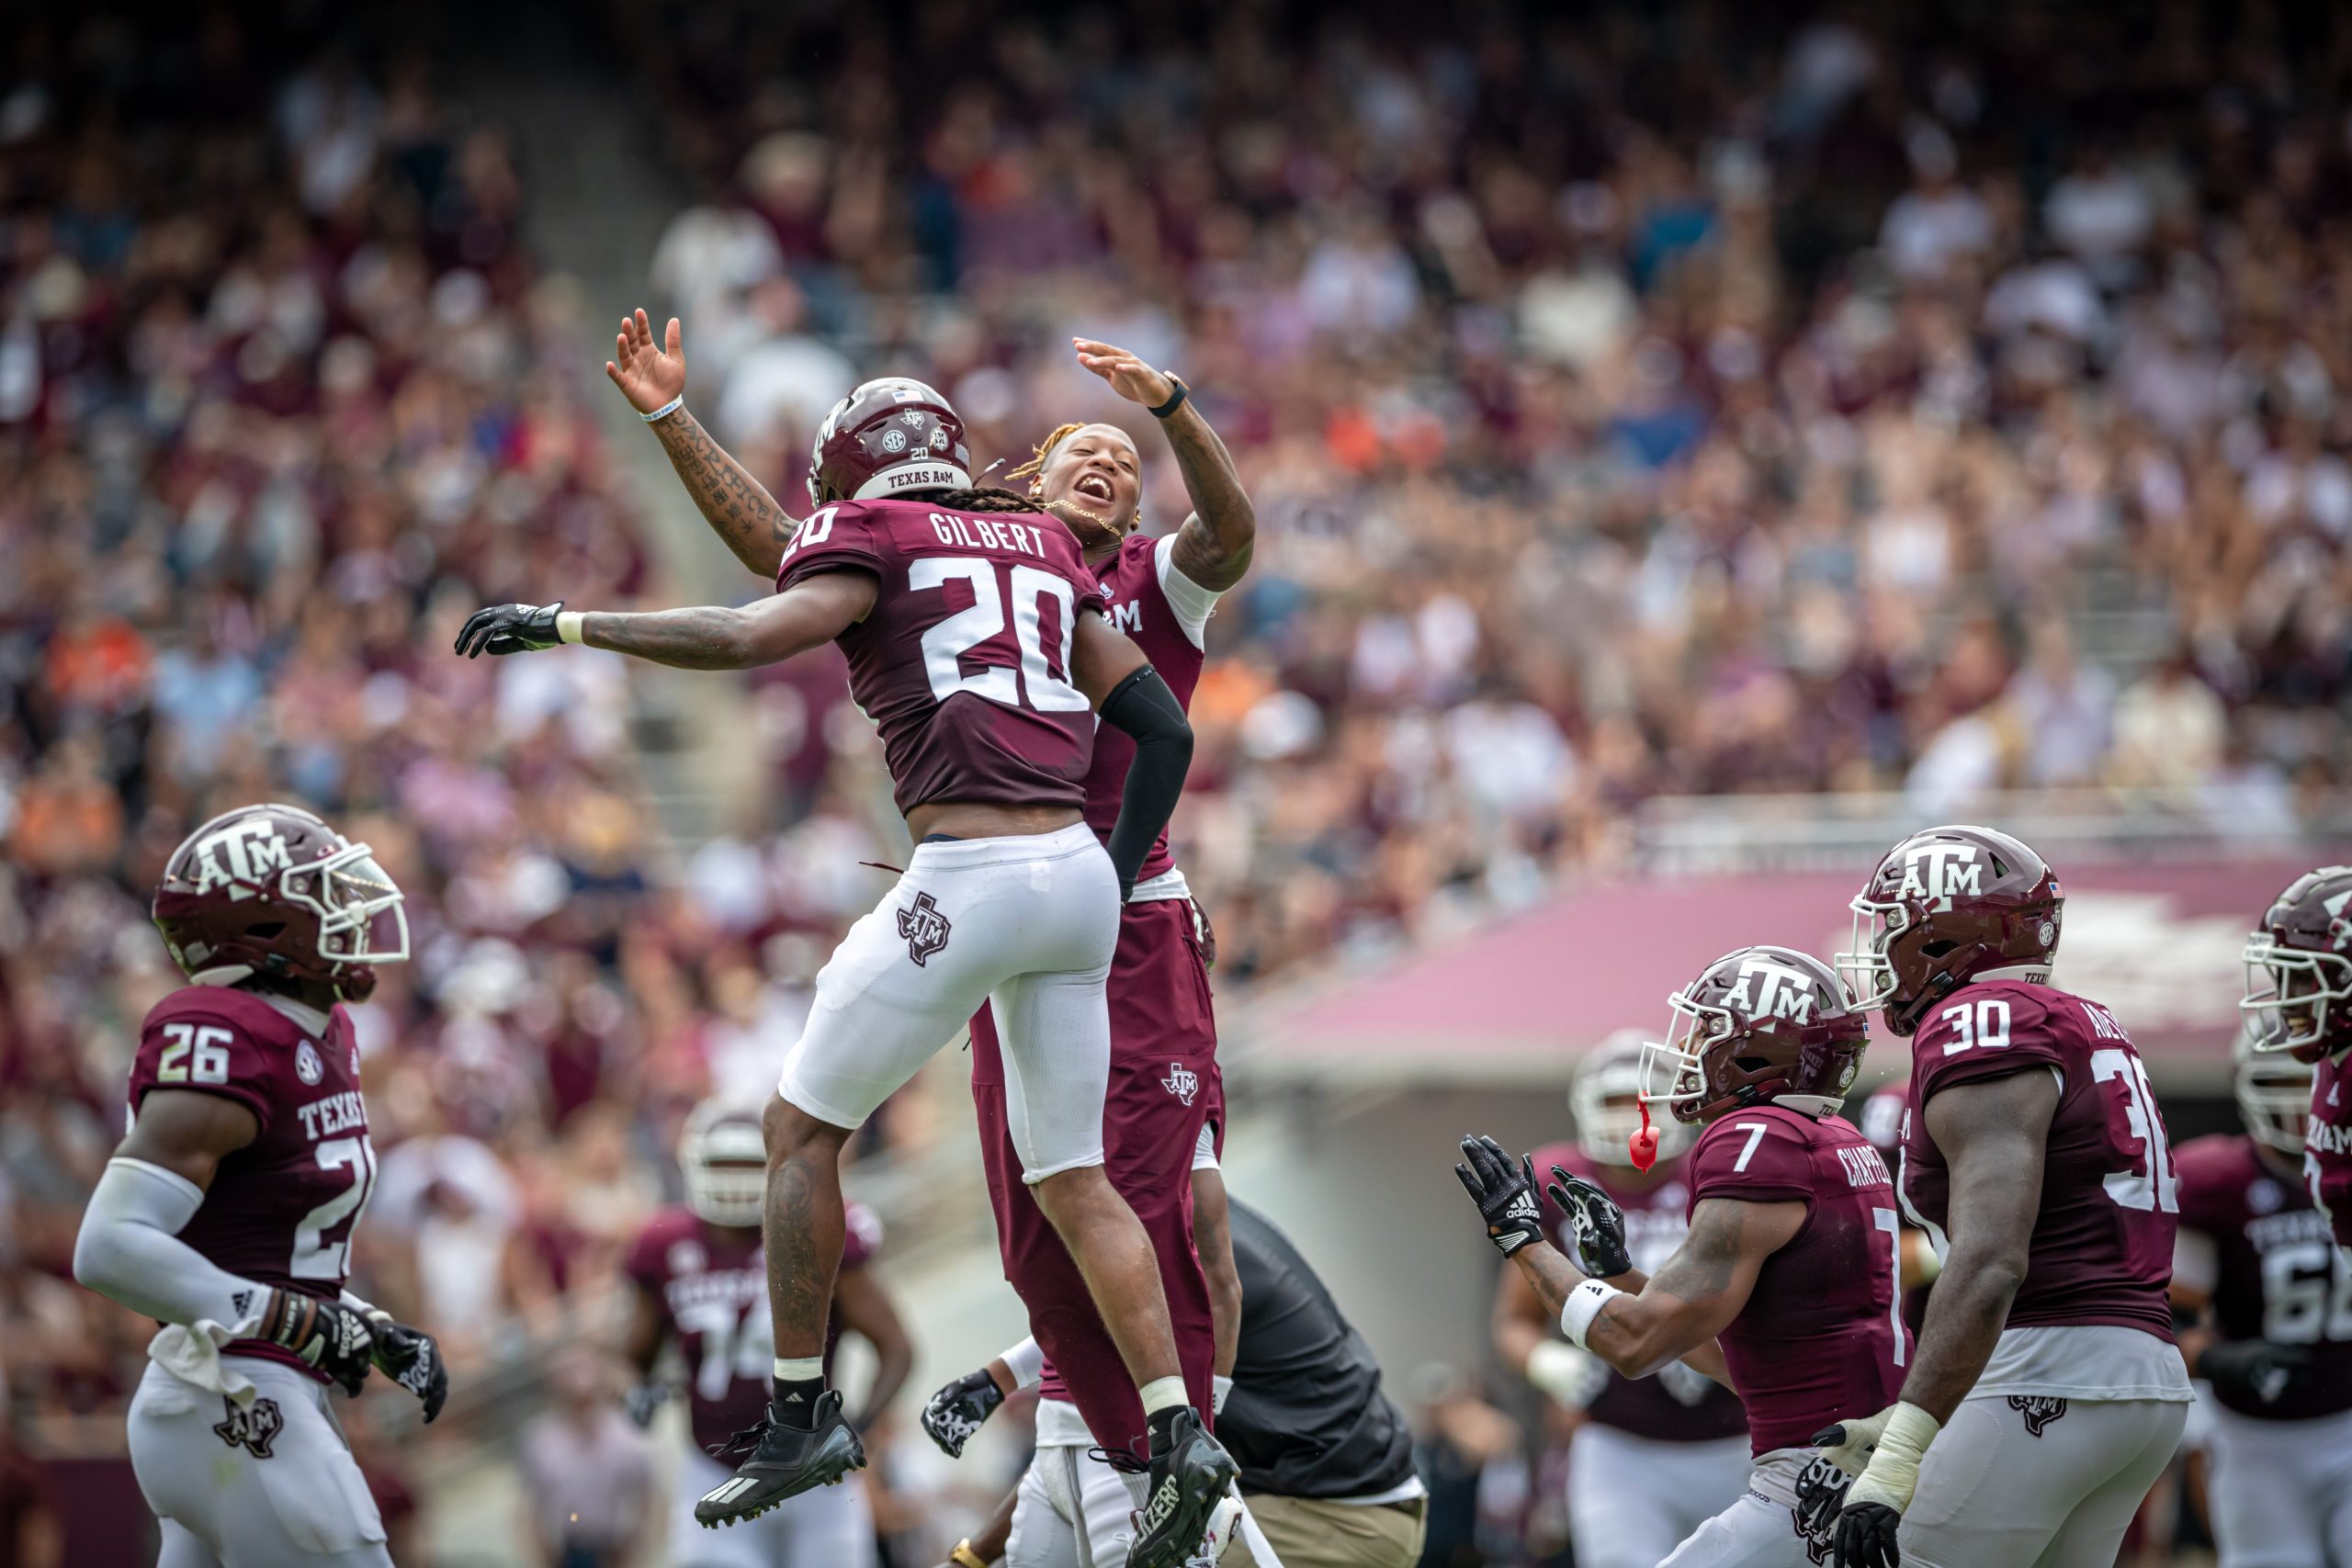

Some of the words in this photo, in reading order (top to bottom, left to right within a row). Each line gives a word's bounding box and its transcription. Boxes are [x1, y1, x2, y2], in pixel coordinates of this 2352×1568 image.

[885, 432, 904, 450] SEC
[910, 447, 929, 460] 20
[888, 471, 930, 489] TEXAS
[933, 471, 955, 484] A&M
[929, 513, 1046, 558] GILBERT
[908, 557, 1091, 712] 20
[1894, 844, 1983, 914] ATM
[1720, 962, 1815, 1033] ATM
[158, 1023, 233, 1084] 26
[1941, 999, 2011, 1056] 30
[1734, 1123, 1767, 1172] 7
[1507, 1207, 1540, 1219] adidas
[1872, 1207, 1905, 1367] 7
